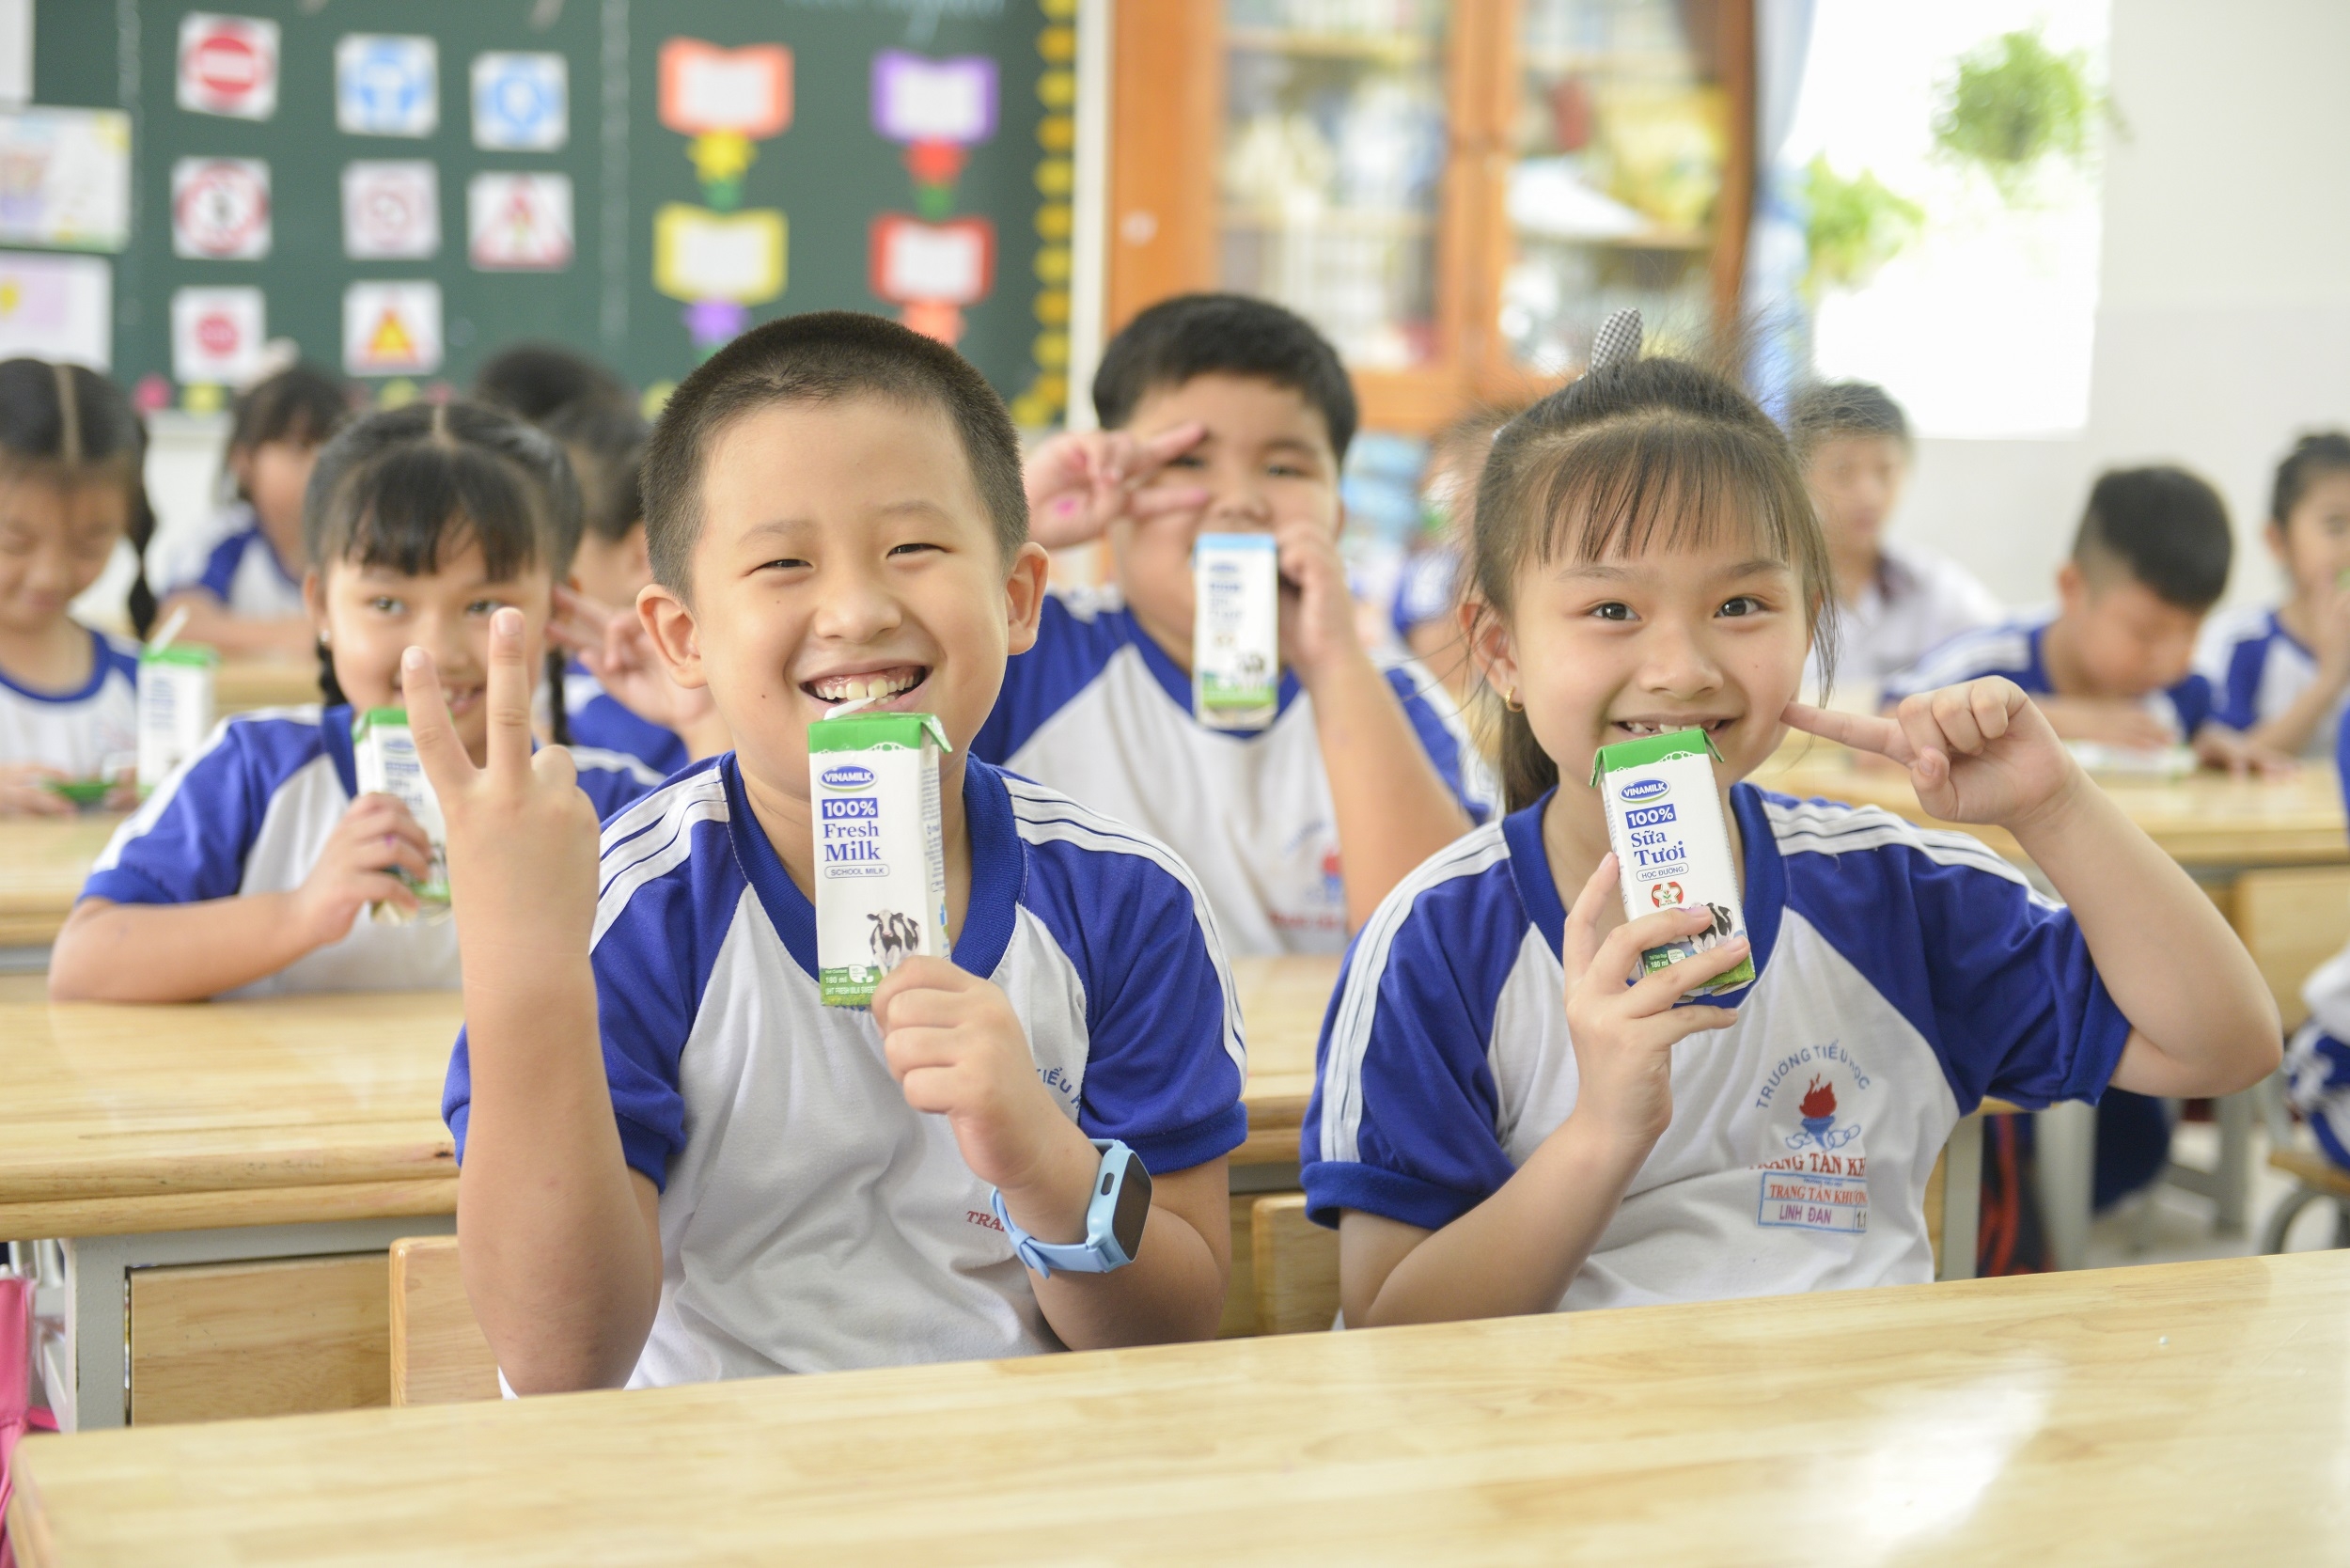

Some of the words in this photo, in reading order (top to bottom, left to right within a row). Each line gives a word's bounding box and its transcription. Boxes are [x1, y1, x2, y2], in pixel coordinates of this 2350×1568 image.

[823, 772, 872, 782] VINAMILK
[1623, 782, 1666, 797] VINAMILK
[823, 800, 877, 817] 100%
[1628, 807, 1674, 826] 100%
[822, 820, 880, 839] Fresh
[1631, 830, 1668, 848] Sữa
[823, 839, 881, 862] Milk
[1634, 840, 1687, 867] Tươi
[830, 868, 863, 876] SCHOOL
[865, 867, 885, 875] MILK
[1641, 870, 1657, 881] HỌC
[1658, 866, 1684, 877] ĐƯỜNG
[825, 976, 837, 984] 180
[1037, 1066, 1073, 1093] IỂU
[1756, 1047, 1811, 1108] TRƯỜNG
[1770, 1184, 1806, 1200] TRANG
[1834, 1189, 1868, 1206] KHƯƠN
[966, 1210, 1005, 1232] TRA
[1779, 1204, 1803, 1221] LINH
[1808, 1206, 1832, 1225] ĐAN
